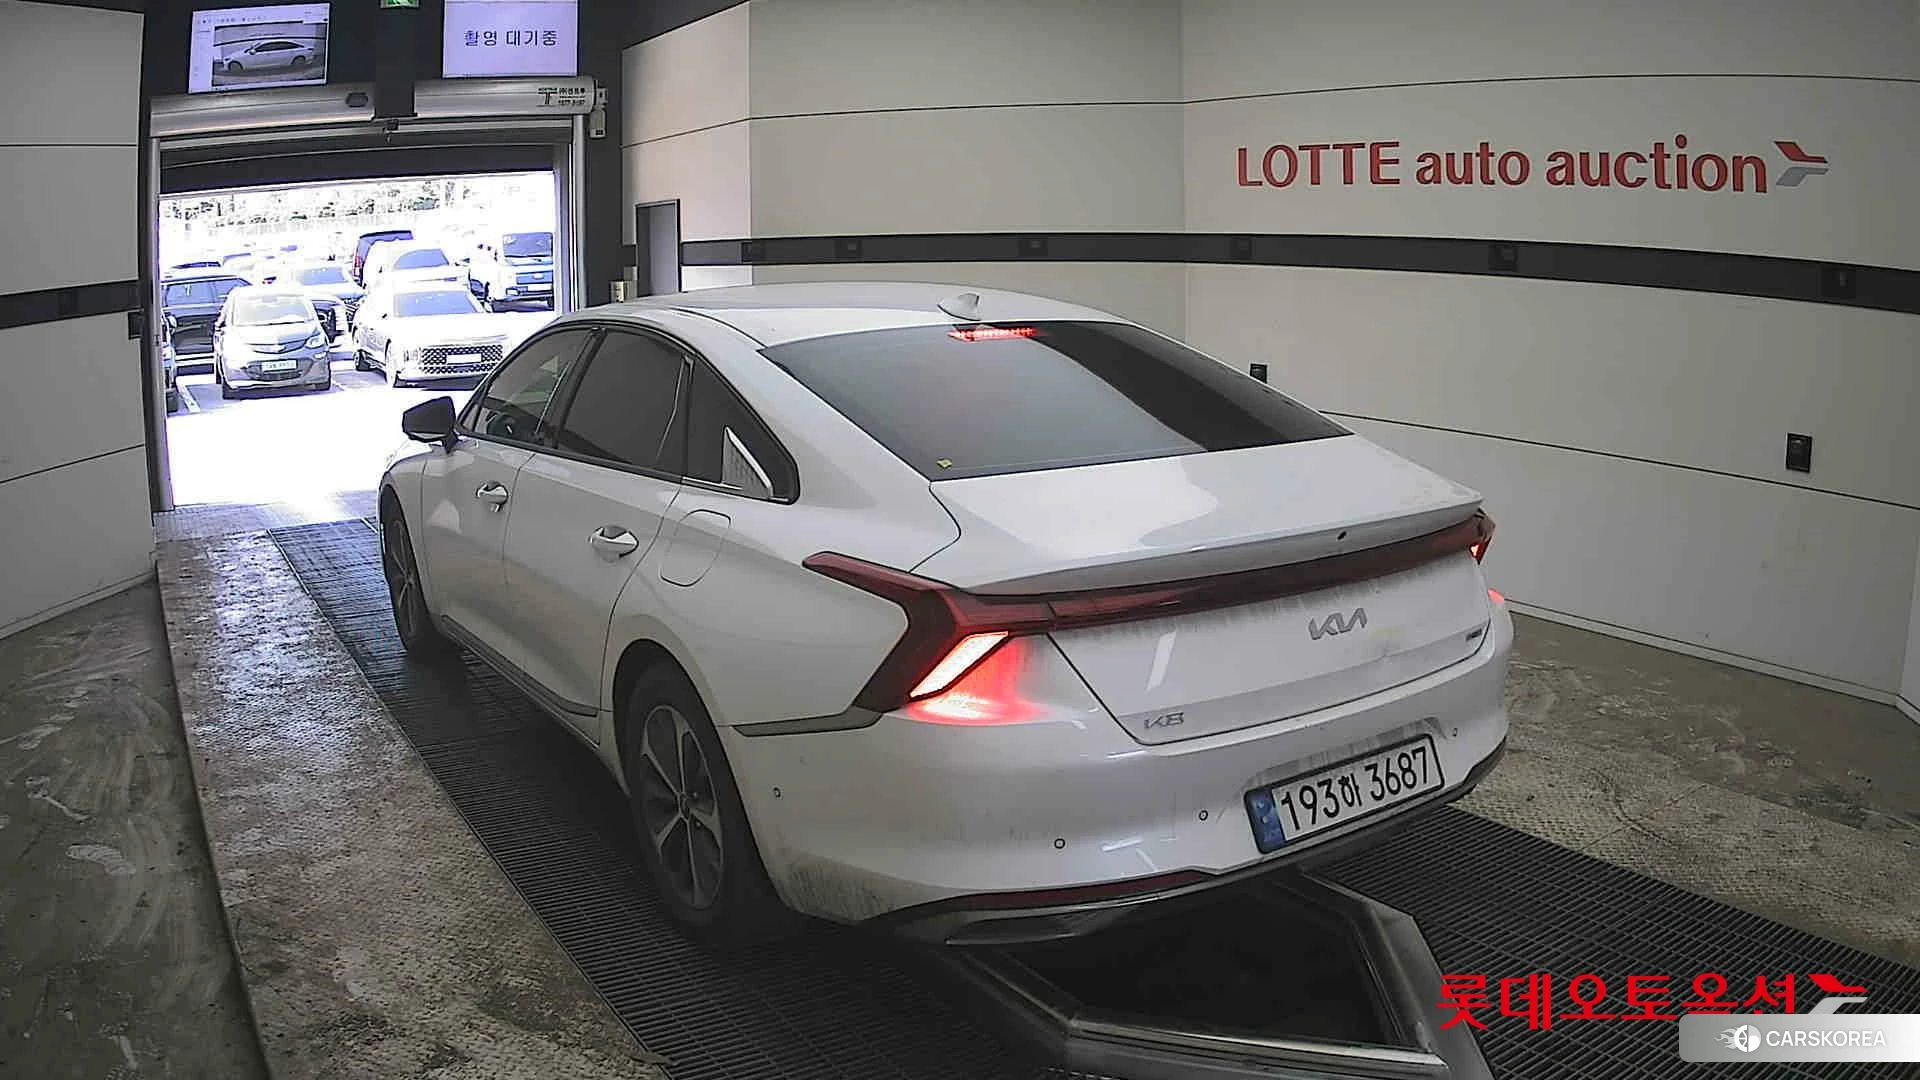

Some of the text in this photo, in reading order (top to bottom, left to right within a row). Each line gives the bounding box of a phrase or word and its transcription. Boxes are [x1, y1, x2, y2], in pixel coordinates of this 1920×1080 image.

[464, 30, 557, 47] 촬영 대기중
[1237, 134, 1768, 194] LOTTE auto auction
[1143, 711, 1185, 729] K8
[1364, 745, 1429, 801] 3687
